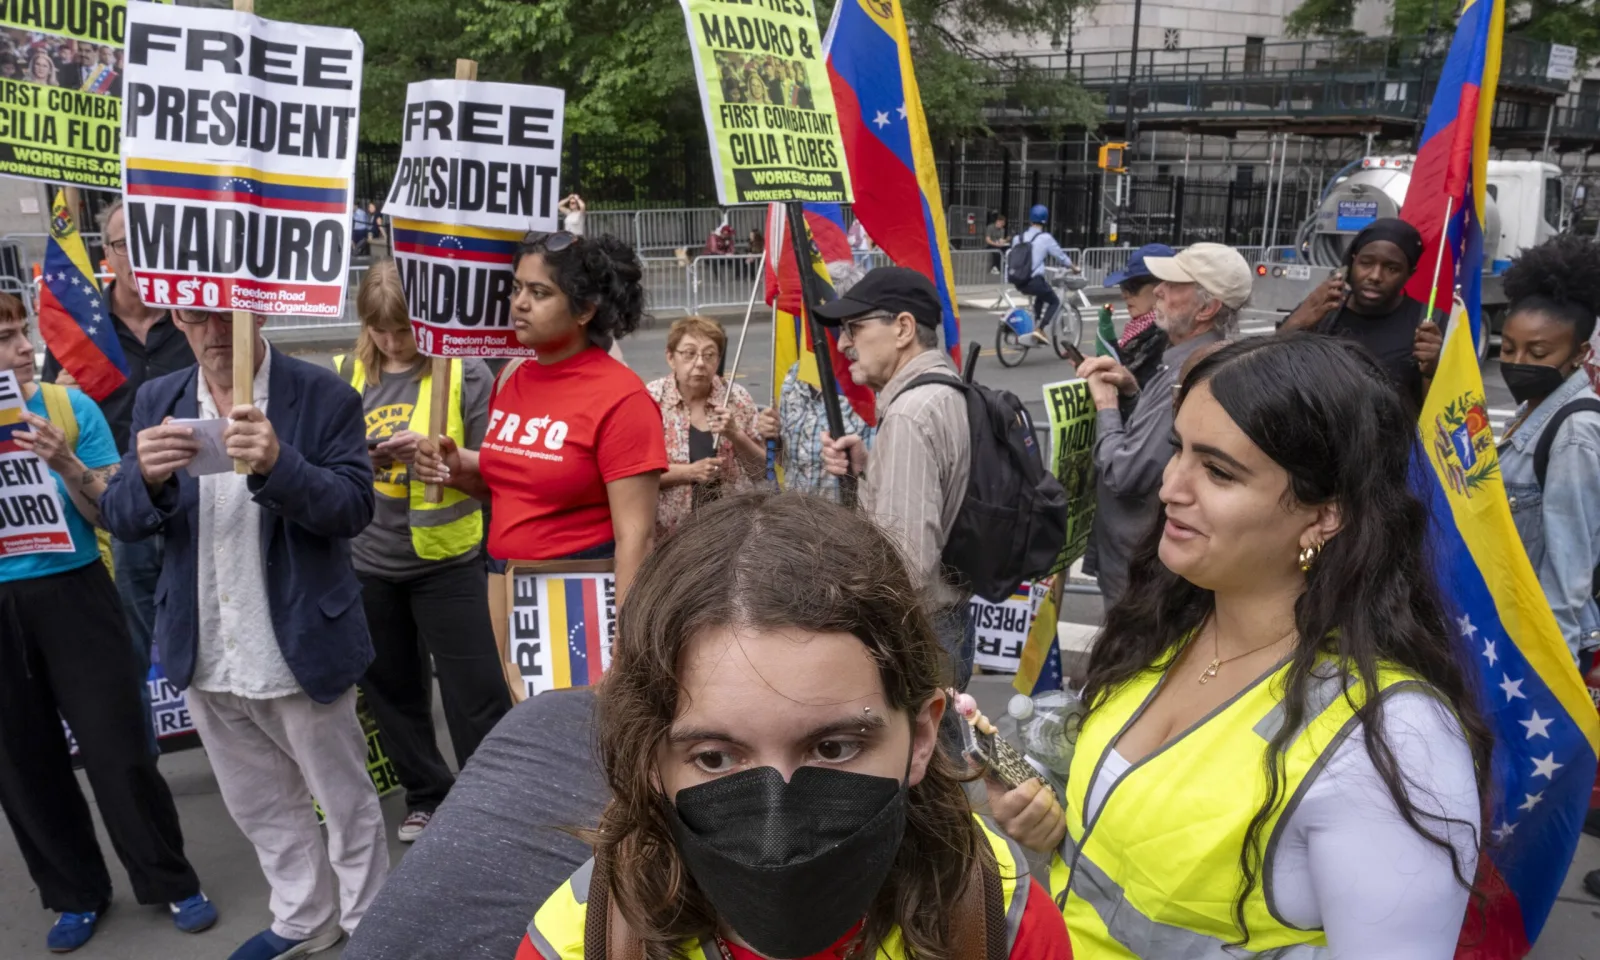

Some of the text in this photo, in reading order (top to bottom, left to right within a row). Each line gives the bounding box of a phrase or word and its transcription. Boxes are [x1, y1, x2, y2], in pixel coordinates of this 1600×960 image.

[699, 12, 816, 60] MADURO &
[128, 22, 354, 91] FREE
[0, 80, 122, 121] IRST COMBA
[125, 82, 356, 160] PRESIDENT
[404, 100, 555, 150] FREE
[719, 104, 834, 135] FIRST COMBATANT
[729, 132, 838, 168] CILIA FLORES
[0, 160, 61, 179] WORKERS
[62, 170, 108, 186] WORLD
[389, 156, 558, 218] PRESIDENT
[751, 170, 833, 187] WORKERS.ORG
[743, 189, 793, 201] WORKERS
[817, 191, 843, 202] PARTY
[127, 202, 346, 284] MADURO
[231, 284, 306, 301] Freedom Road
[231, 297, 337, 315] Socialist Organization
[395, 256, 514, 327] MADUR
[442, 334, 508, 346] Freedom Road
[442, 344, 536, 357] Socialist Organization
[485, 408, 569, 450] FRSO
[0, 457, 43, 488] ENT
